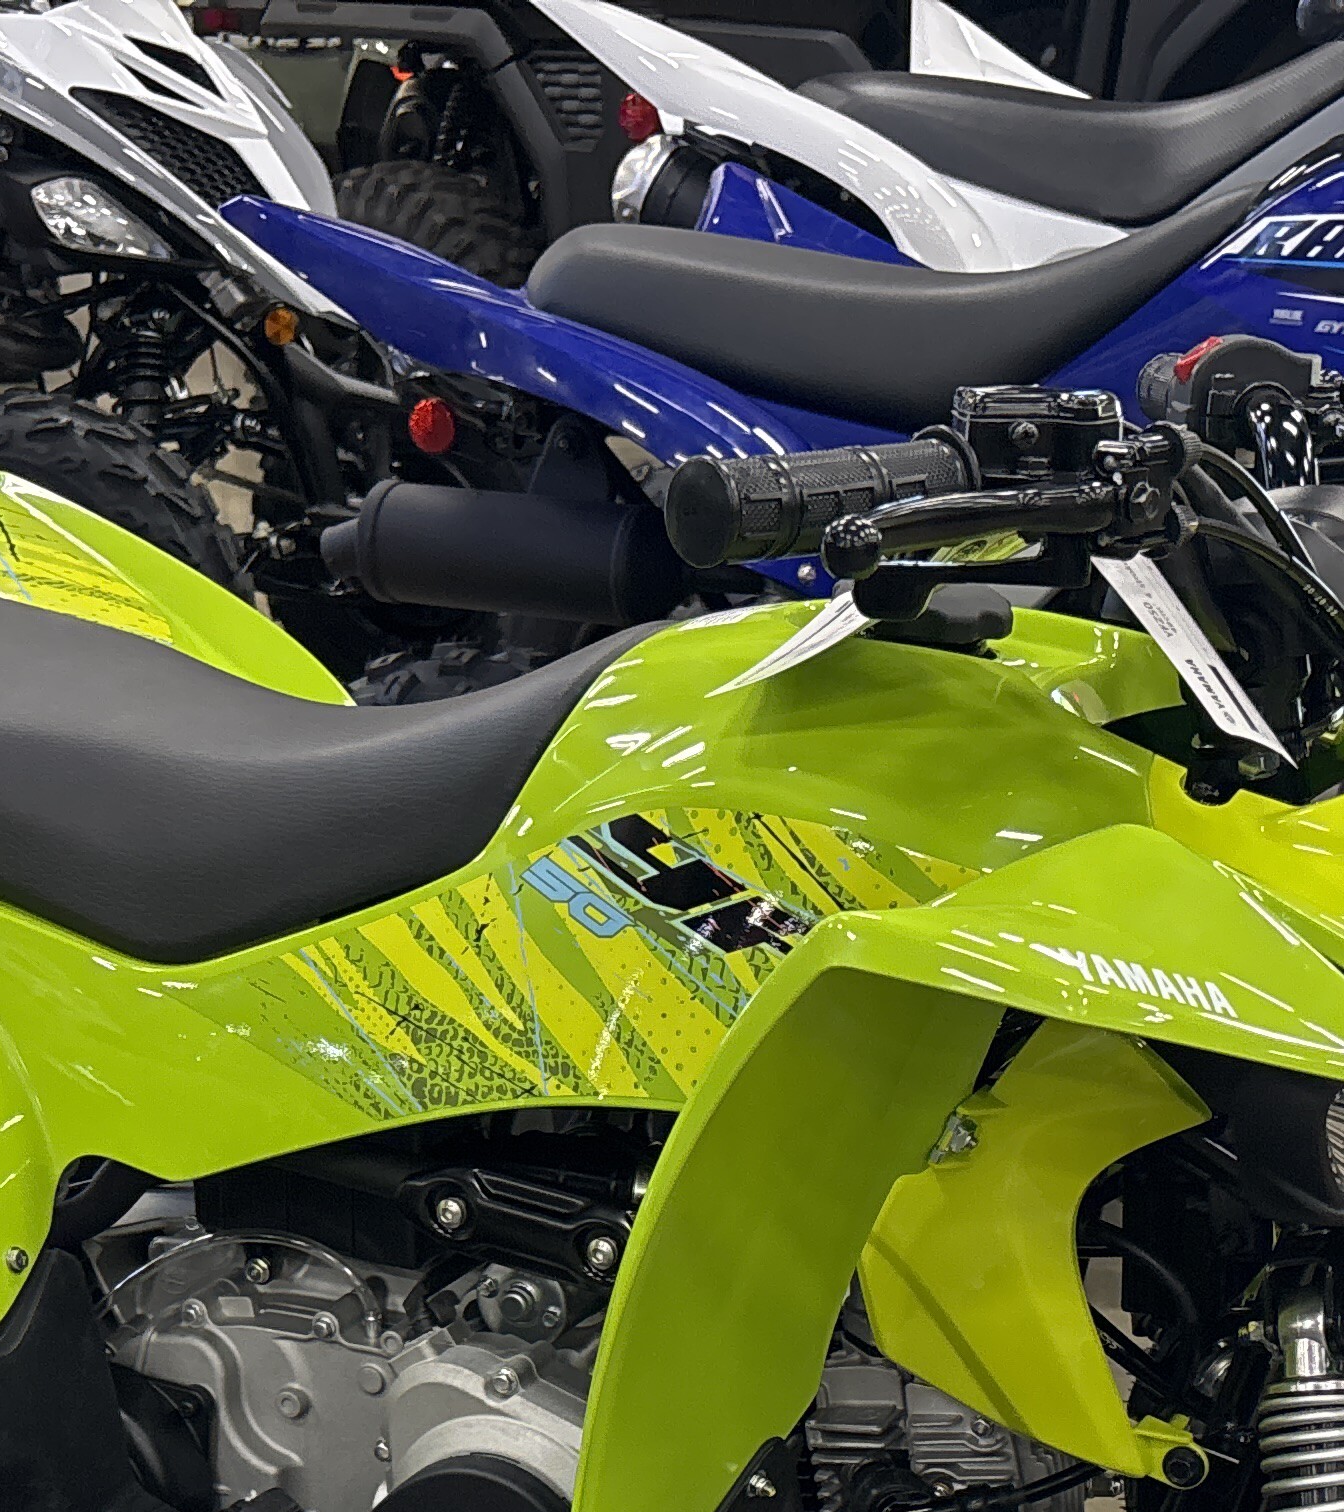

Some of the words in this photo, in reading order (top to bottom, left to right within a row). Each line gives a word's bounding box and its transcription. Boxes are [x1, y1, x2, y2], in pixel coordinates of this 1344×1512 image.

[1185, 658, 1225, 710] YAMAHA
[520, 855, 636, 938] 50
[1057, 947, 1238, 1019] YAMAHA
